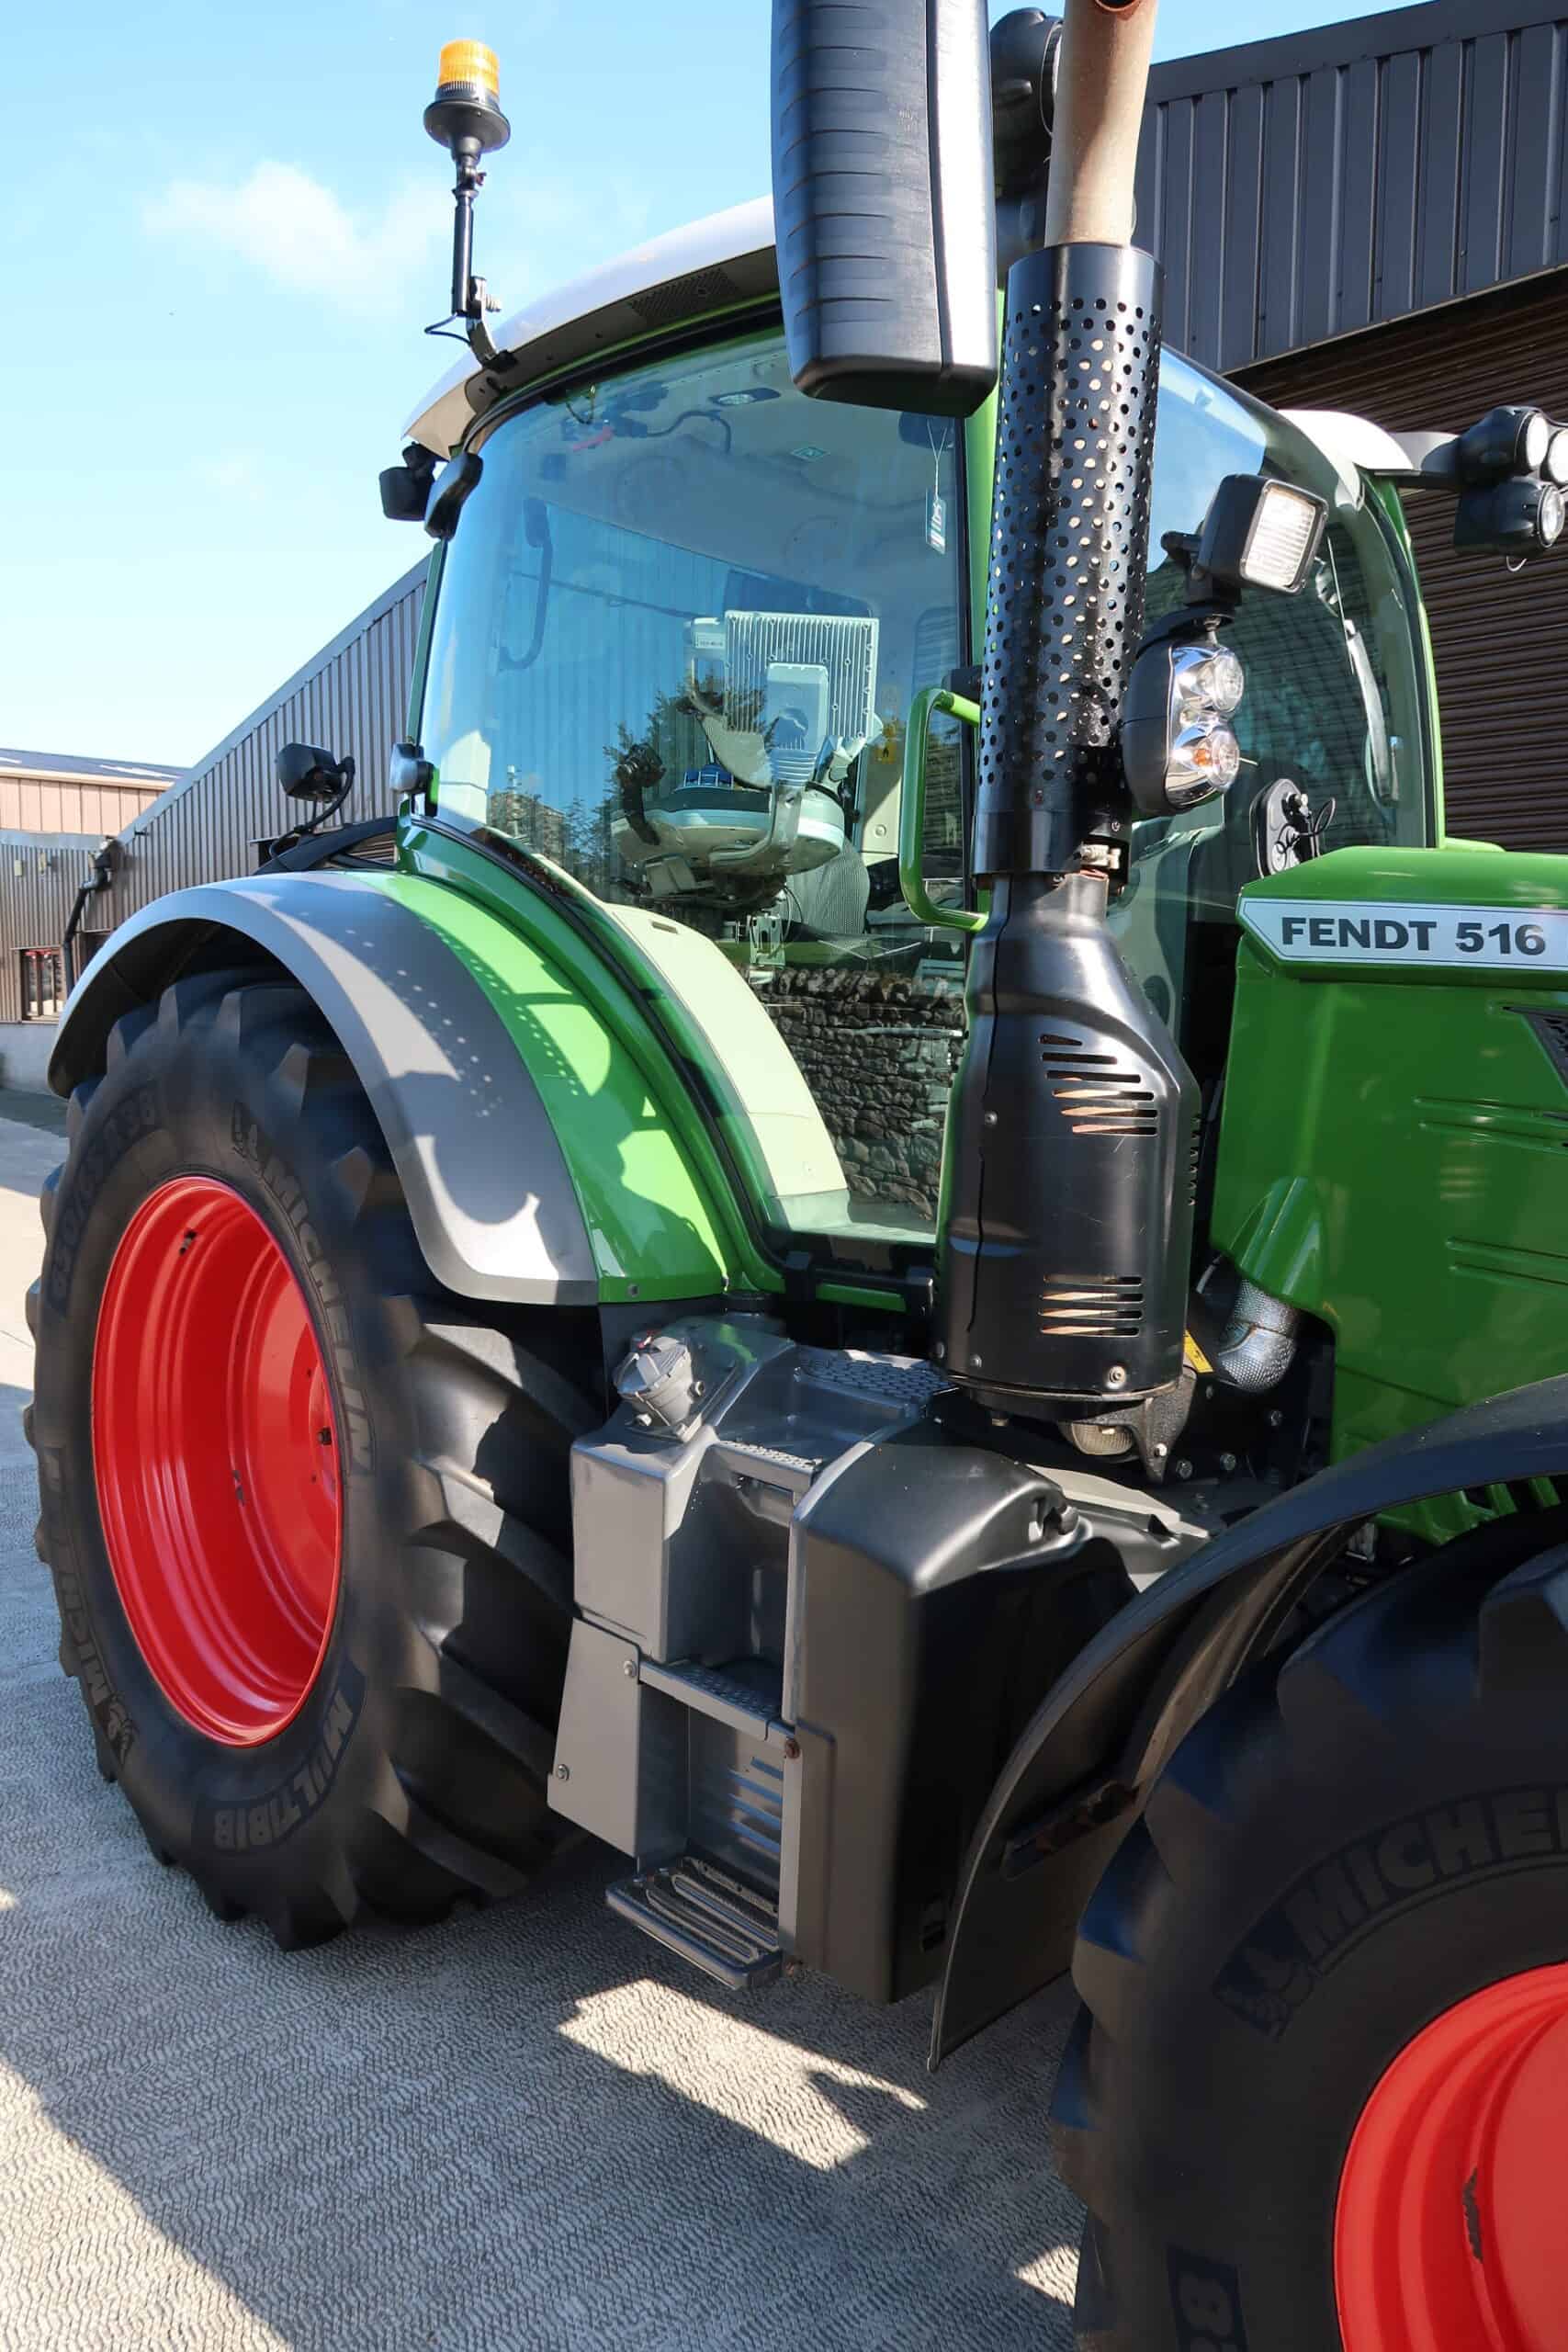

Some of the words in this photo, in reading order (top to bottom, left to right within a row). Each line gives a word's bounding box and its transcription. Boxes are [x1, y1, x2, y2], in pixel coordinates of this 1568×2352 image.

[1282, 917, 1437, 951] FENDT
[1455, 923, 1546, 956] 516
[263, 1149, 374, 1469] MICHELIN
[213, 1688, 356, 1850] MULTIBIB
[1284, 1788, 1568, 1959] MICHE
